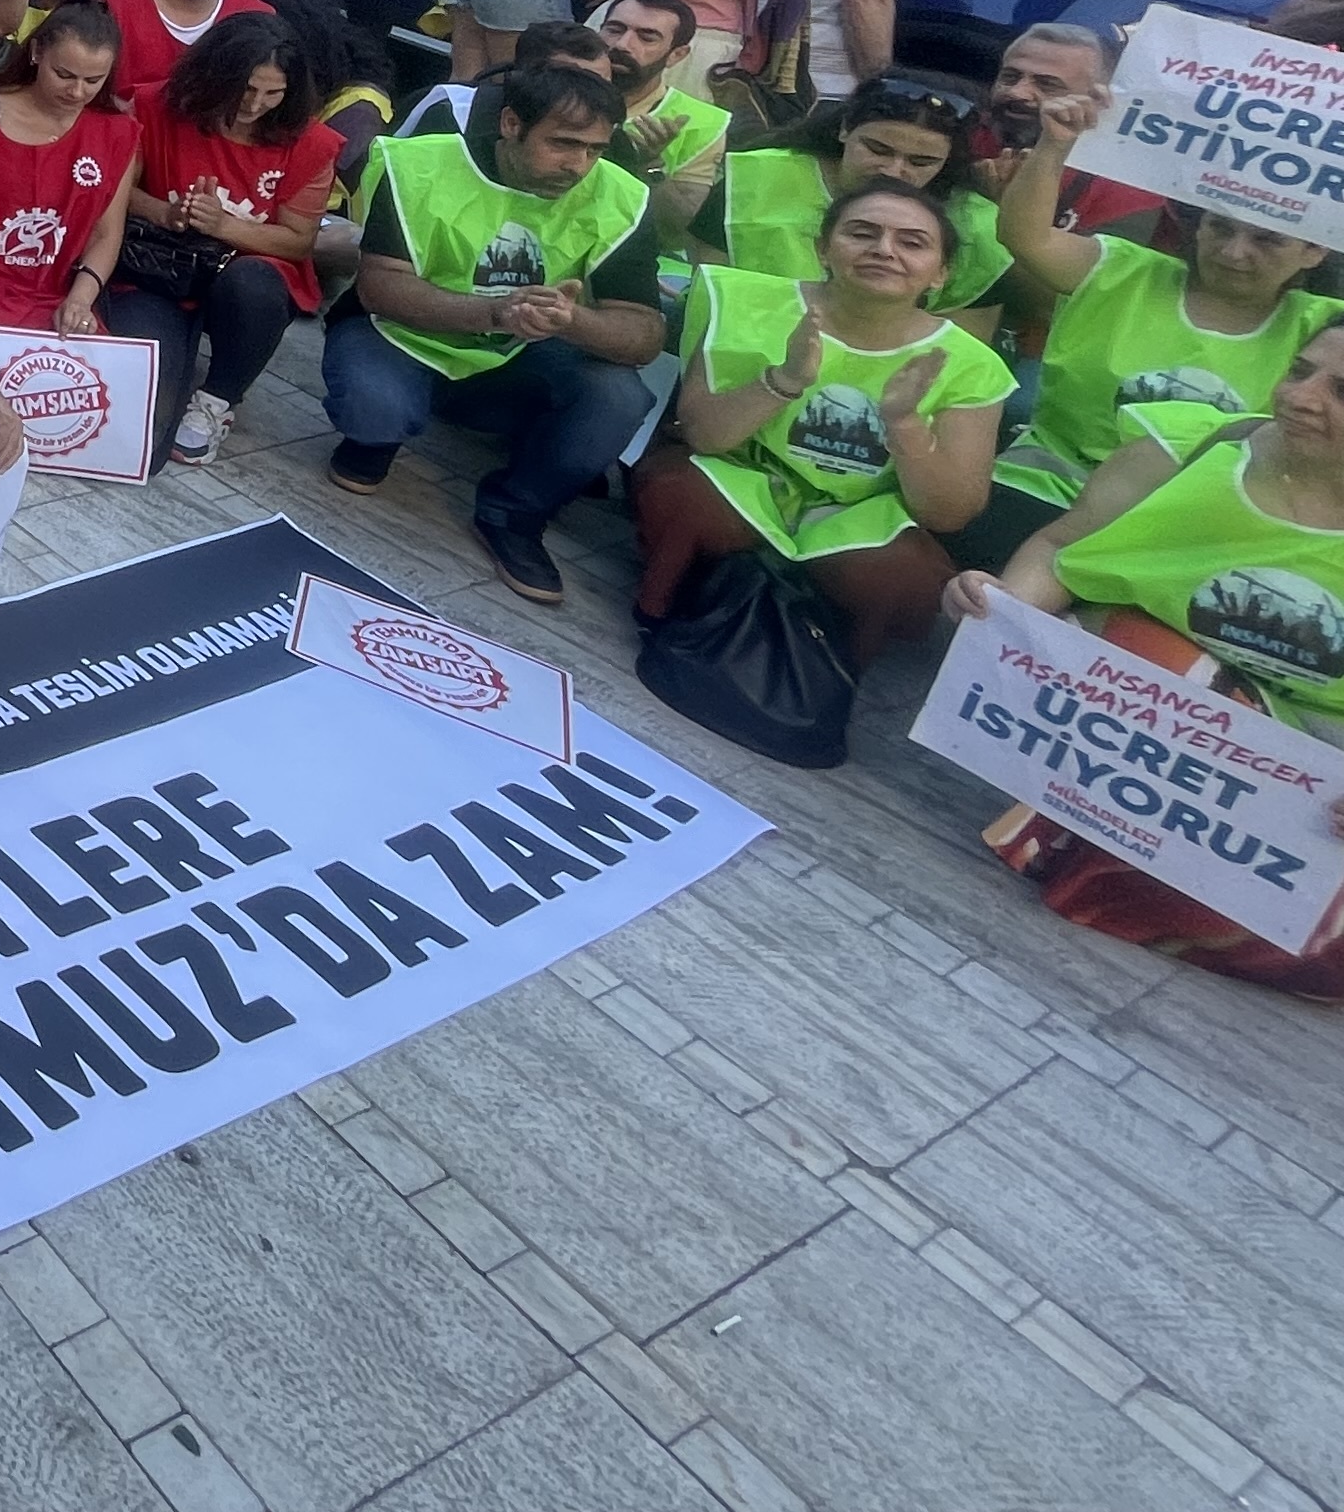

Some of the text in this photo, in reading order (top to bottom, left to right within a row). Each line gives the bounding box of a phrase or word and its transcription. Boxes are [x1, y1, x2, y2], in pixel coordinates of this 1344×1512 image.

[1162, 57, 1315, 106] YAŞAMAYA
[1251, 48, 1344, 85] İNSAN
[1117, 98, 1344, 203] İSTİYOR
[1194, 80, 1344, 156] ÜCRE
[5, 357, 85, 392] TEMMUZ'DA
[12, 386, 101, 416] AMŞART
[10, 657, 154, 717] TESLİM
[136, 603, 293, 678] OLMAMAK
[1087, 656, 1232, 733] İNSANCA
[998, 644, 1325, 794] YAŞAMAYA YETECEK
[1034, 680, 1258, 812] ÜCRET
[957, 683, 1307, 893] İSTİYORUZ
[1047, 780, 1164, 849] MÜCADELECİ
[385, 750, 701, 928] ZAM!
